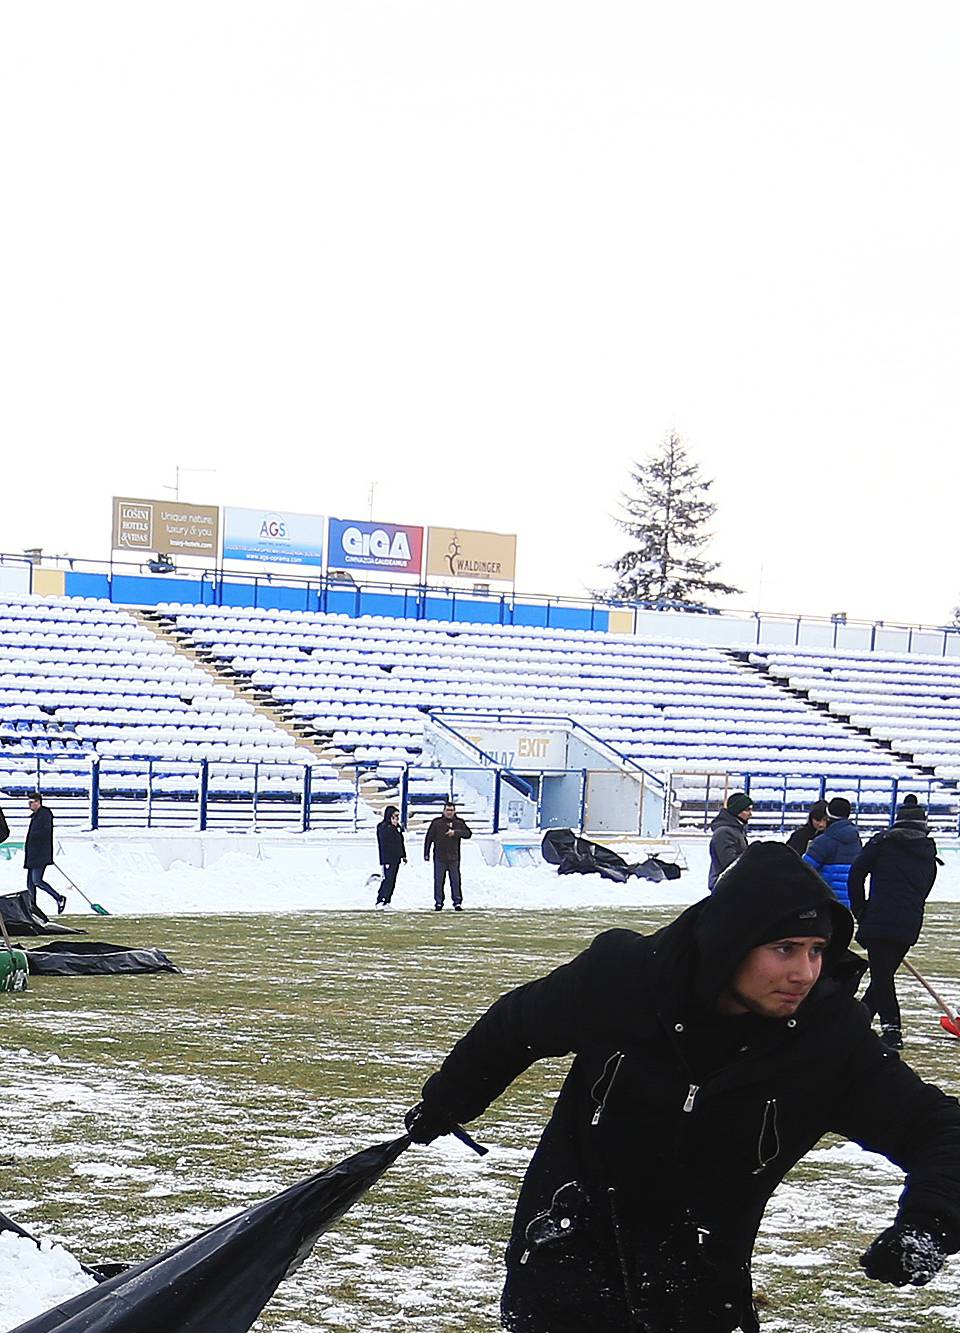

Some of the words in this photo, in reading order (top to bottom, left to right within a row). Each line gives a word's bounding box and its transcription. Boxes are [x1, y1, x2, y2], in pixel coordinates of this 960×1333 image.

[160, 512, 187, 523] Unique
[122, 521, 148, 531] HOTELS
[260, 520, 286, 537] AGS
[342, 526, 412, 560] GIGA
[457, 560, 501, 574] WALDINGER
[518, 738, 550, 757] EXIT
